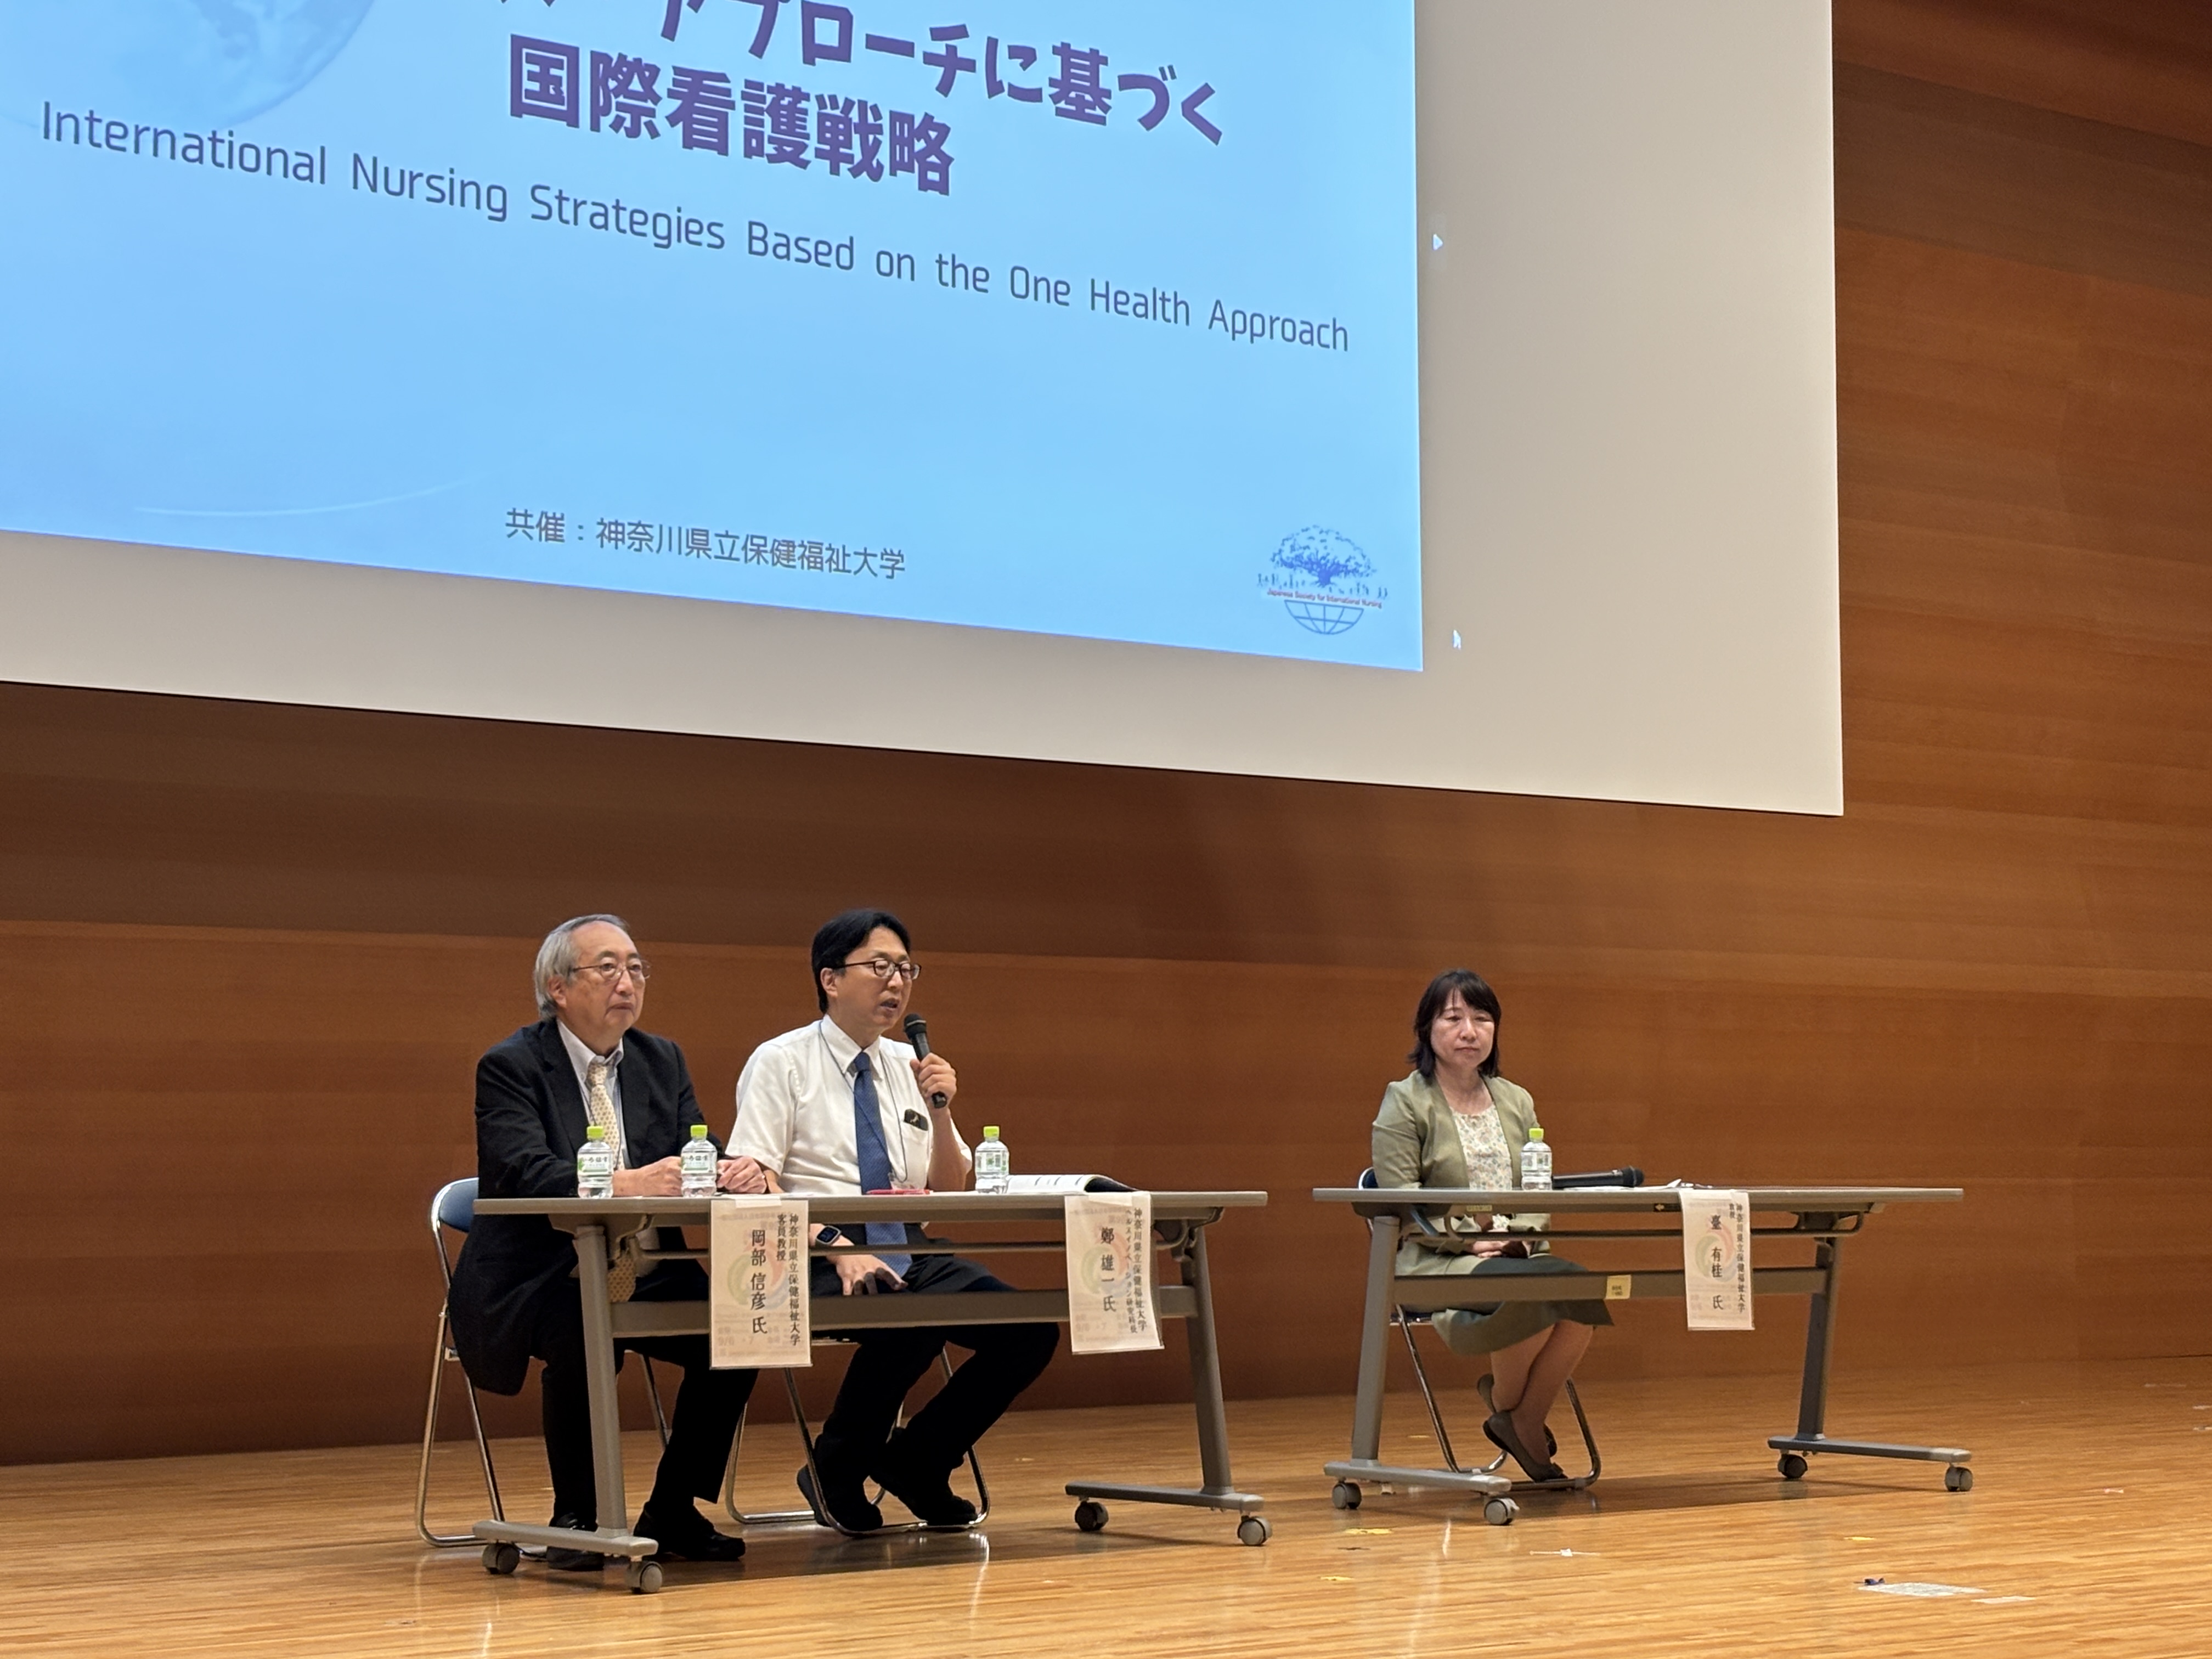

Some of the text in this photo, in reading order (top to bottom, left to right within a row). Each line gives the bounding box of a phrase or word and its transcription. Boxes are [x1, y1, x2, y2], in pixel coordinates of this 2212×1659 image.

[510, 33, 955, 196] 国際看護戦略
[43, 101, 1348, 352] International Nursing Strategies Based on the One Health Approach
[776, 1213, 787, 1262] 客員教授
[788, 1213, 801, 1346] 神奈川県立保健福祉大学
[1133, 1207, 1147, 1332] 神奈川県立保健福祉大学
[1103, 1295, 1116, 1312] 氏
[1712, 1294, 1724, 1310] 氏
